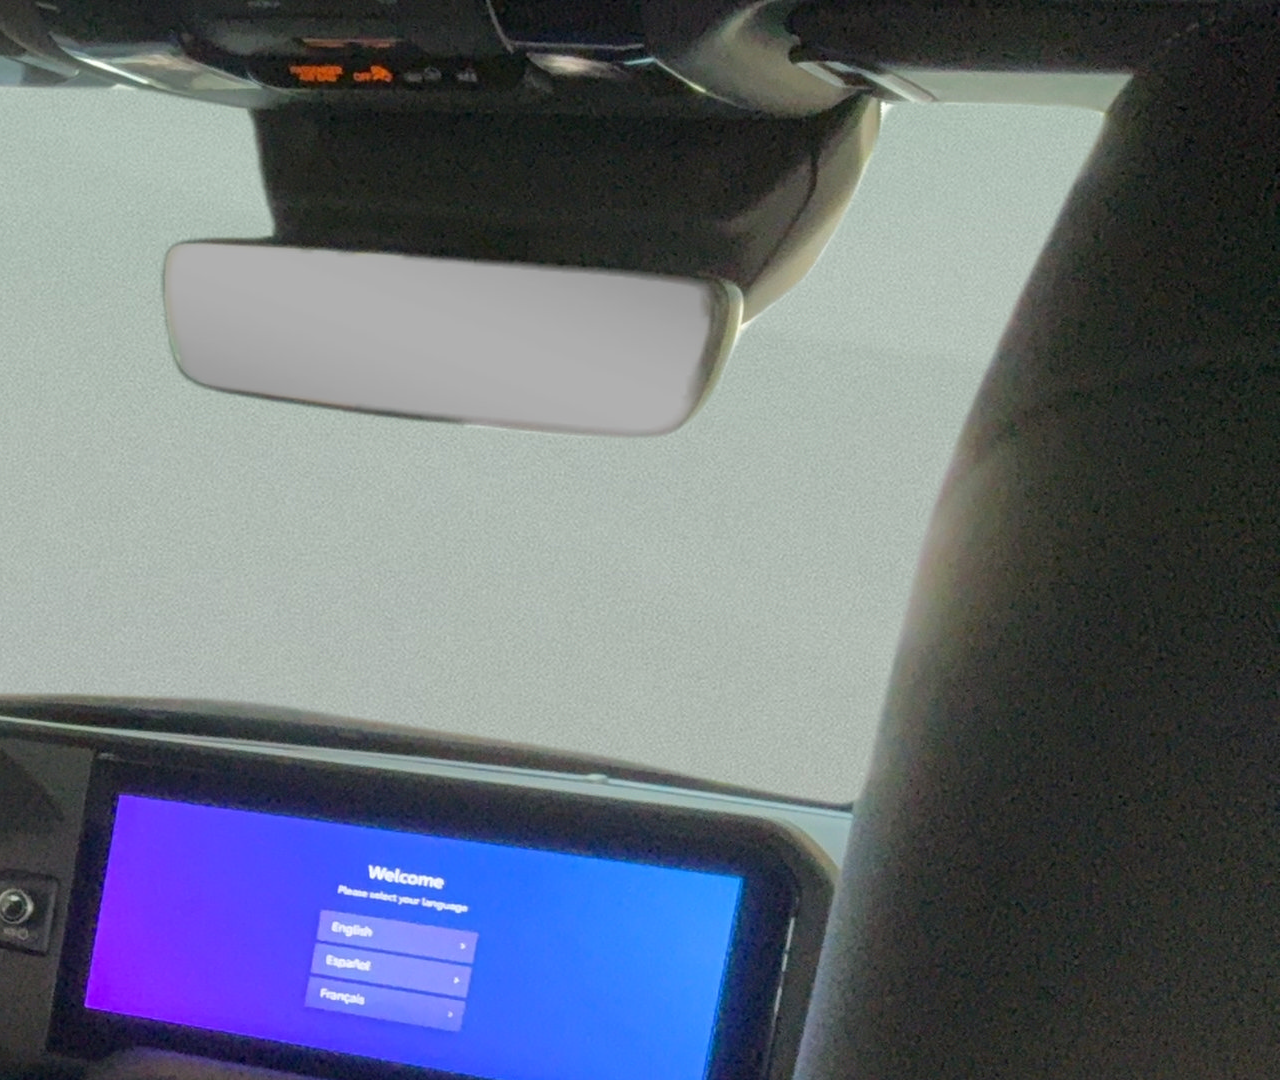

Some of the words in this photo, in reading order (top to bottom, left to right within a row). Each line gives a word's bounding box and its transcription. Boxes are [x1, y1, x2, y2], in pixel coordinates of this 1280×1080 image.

[368, 865, 445, 890] Welcome
[337, 884, 368, 899] Please
[369, 891, 397, 903] select
[398, 895, 420, 905] your
[421, 897, 468, 914] language
[331, 921, 373, 937] English
[325, 954, 371, 972] Español
[319, 987, 366, 1006] Français
